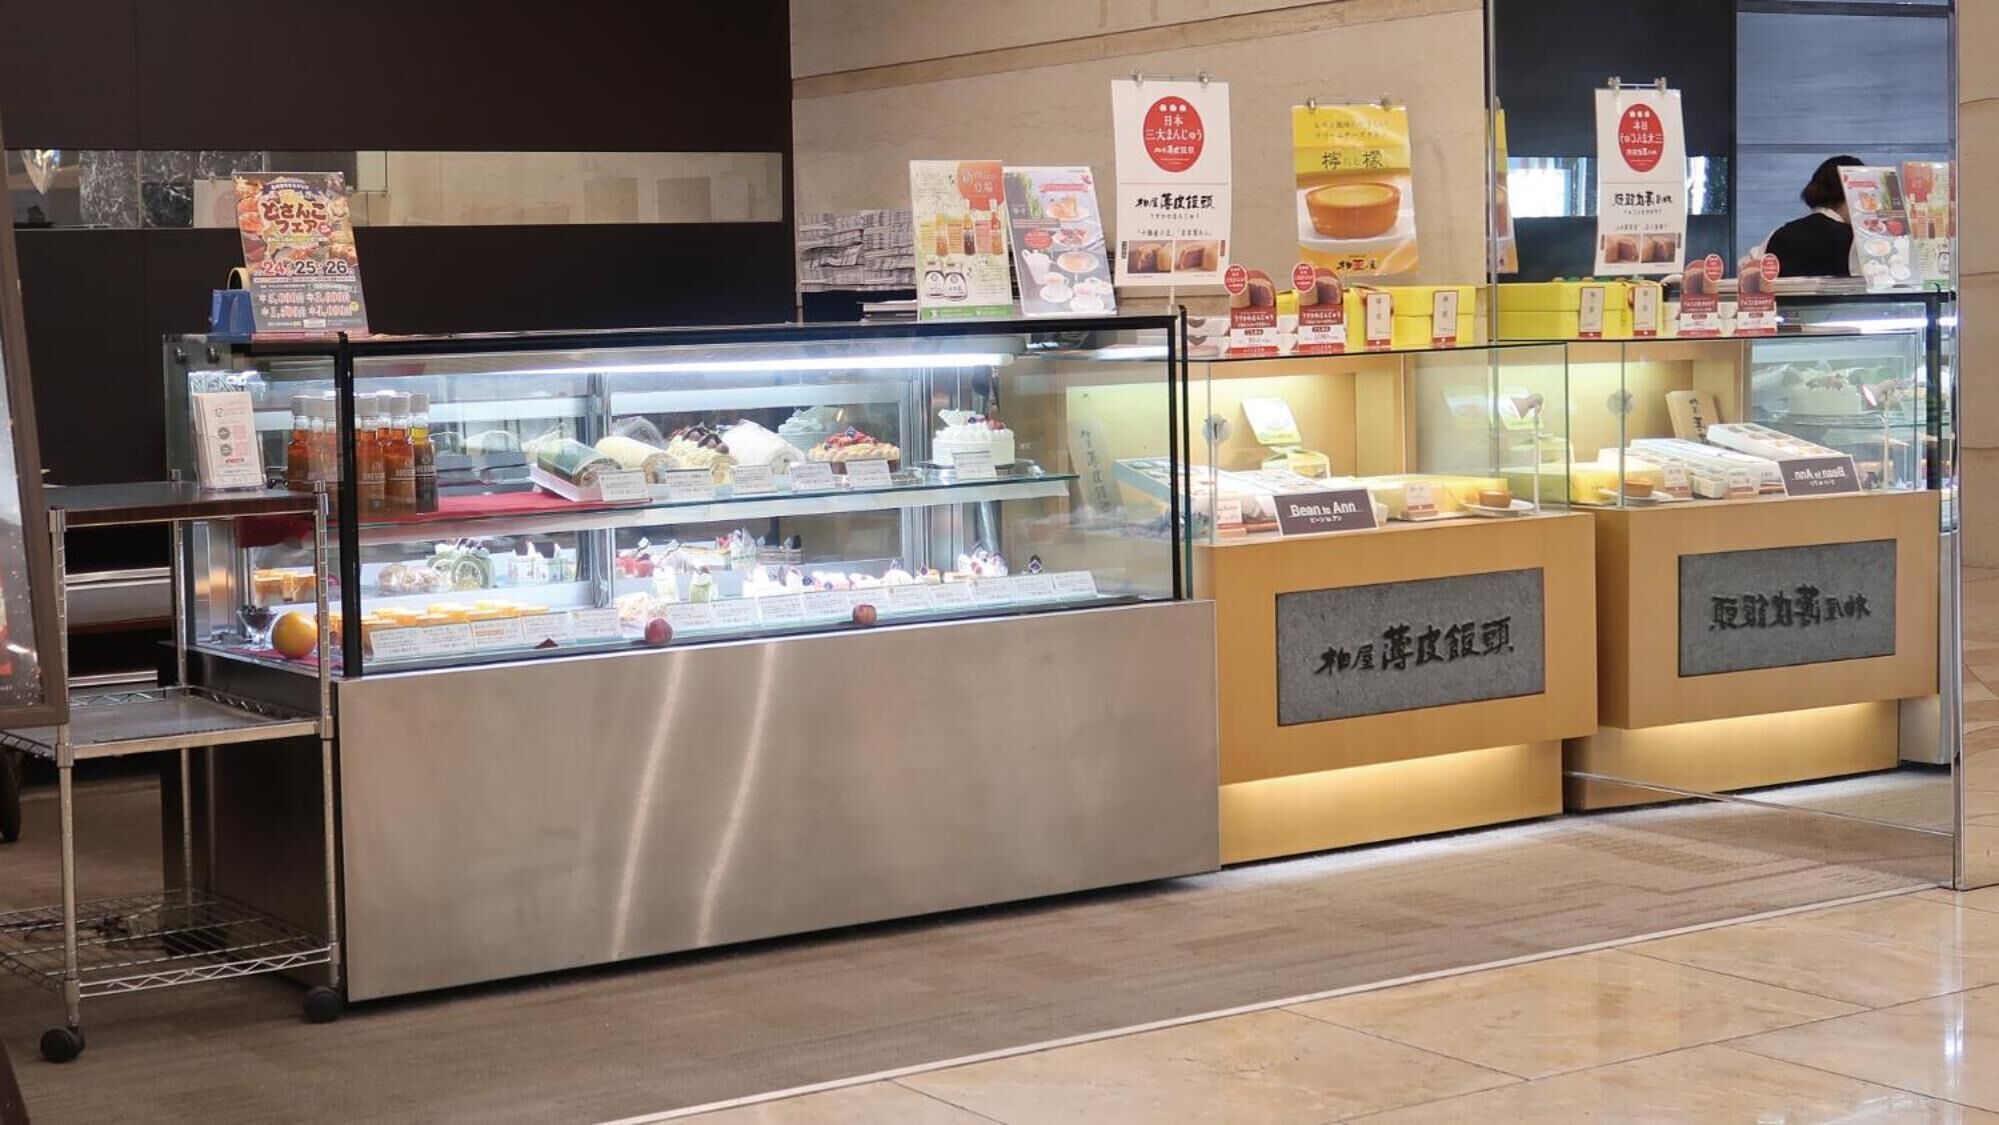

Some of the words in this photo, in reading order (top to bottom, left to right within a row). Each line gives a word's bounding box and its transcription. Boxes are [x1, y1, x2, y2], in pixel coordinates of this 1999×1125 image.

[1164, 114, 1184, 126] 日本
[1145, 128, 1203, 141] 三大まんじゅう
[261, 202, 327, 220] どさんこ
[276, 219, 318, 233] フェア
[263, 261, 285, 274] 24
[295, 261, 316, 274] 25
[326, 260, 347, 274] 26
[1290, 503, 1322, 517] Bean
[1322, 506, 1331, 514] to
[1332, 501, 1356, 514] Ann
[1314, 616, 1515, 675] 柏屋薄皮饅頭
